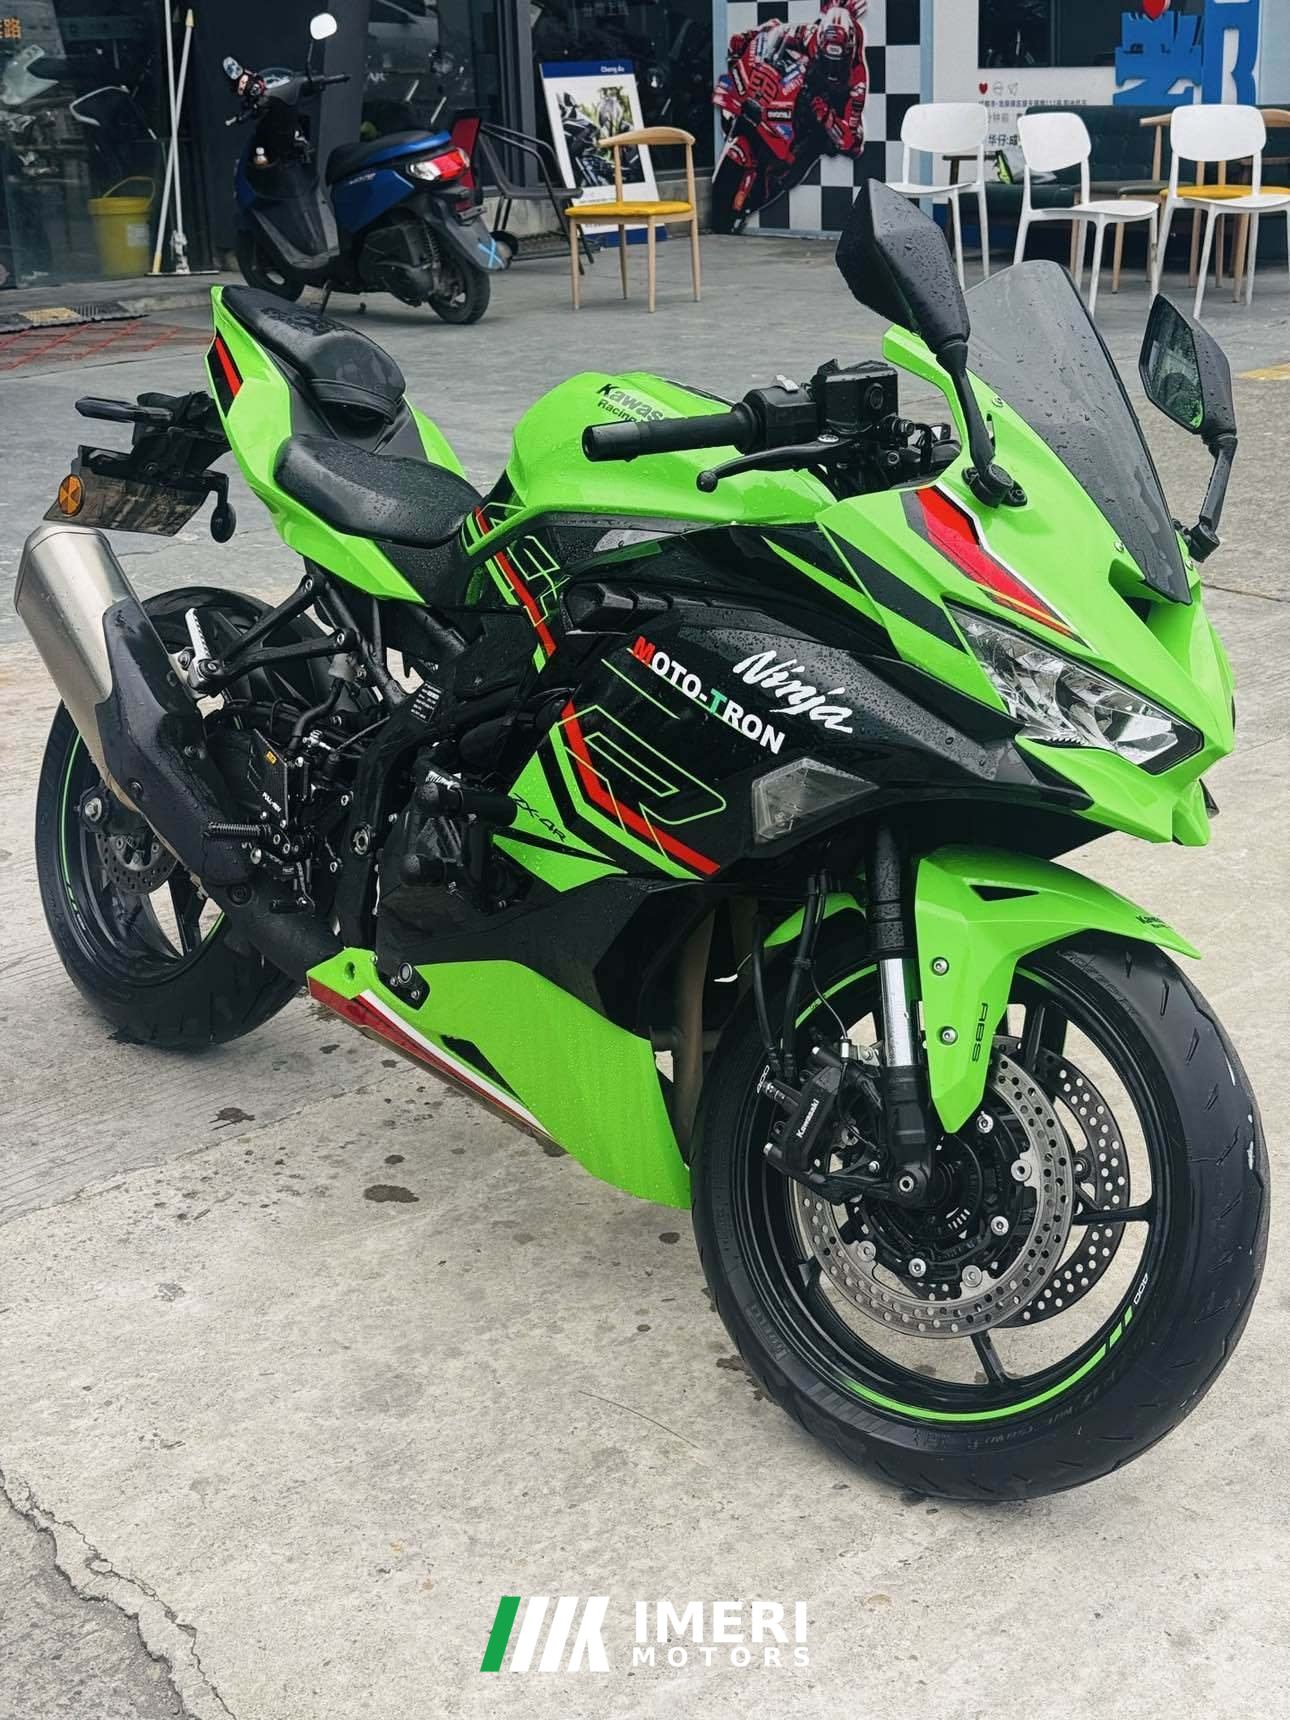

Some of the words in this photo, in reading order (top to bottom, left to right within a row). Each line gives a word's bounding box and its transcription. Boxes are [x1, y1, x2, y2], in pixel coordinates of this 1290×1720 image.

[0, 18, 22, 39] 路
[596, 383, 664, 422] Kawas
[631, 635, 786, 755] MOTO-TRON
[732, 650, 854, 734] Ninja
[972, 1002, 988, 1062] ABS
[795, 1098, 820, 1138] Kawasaki
